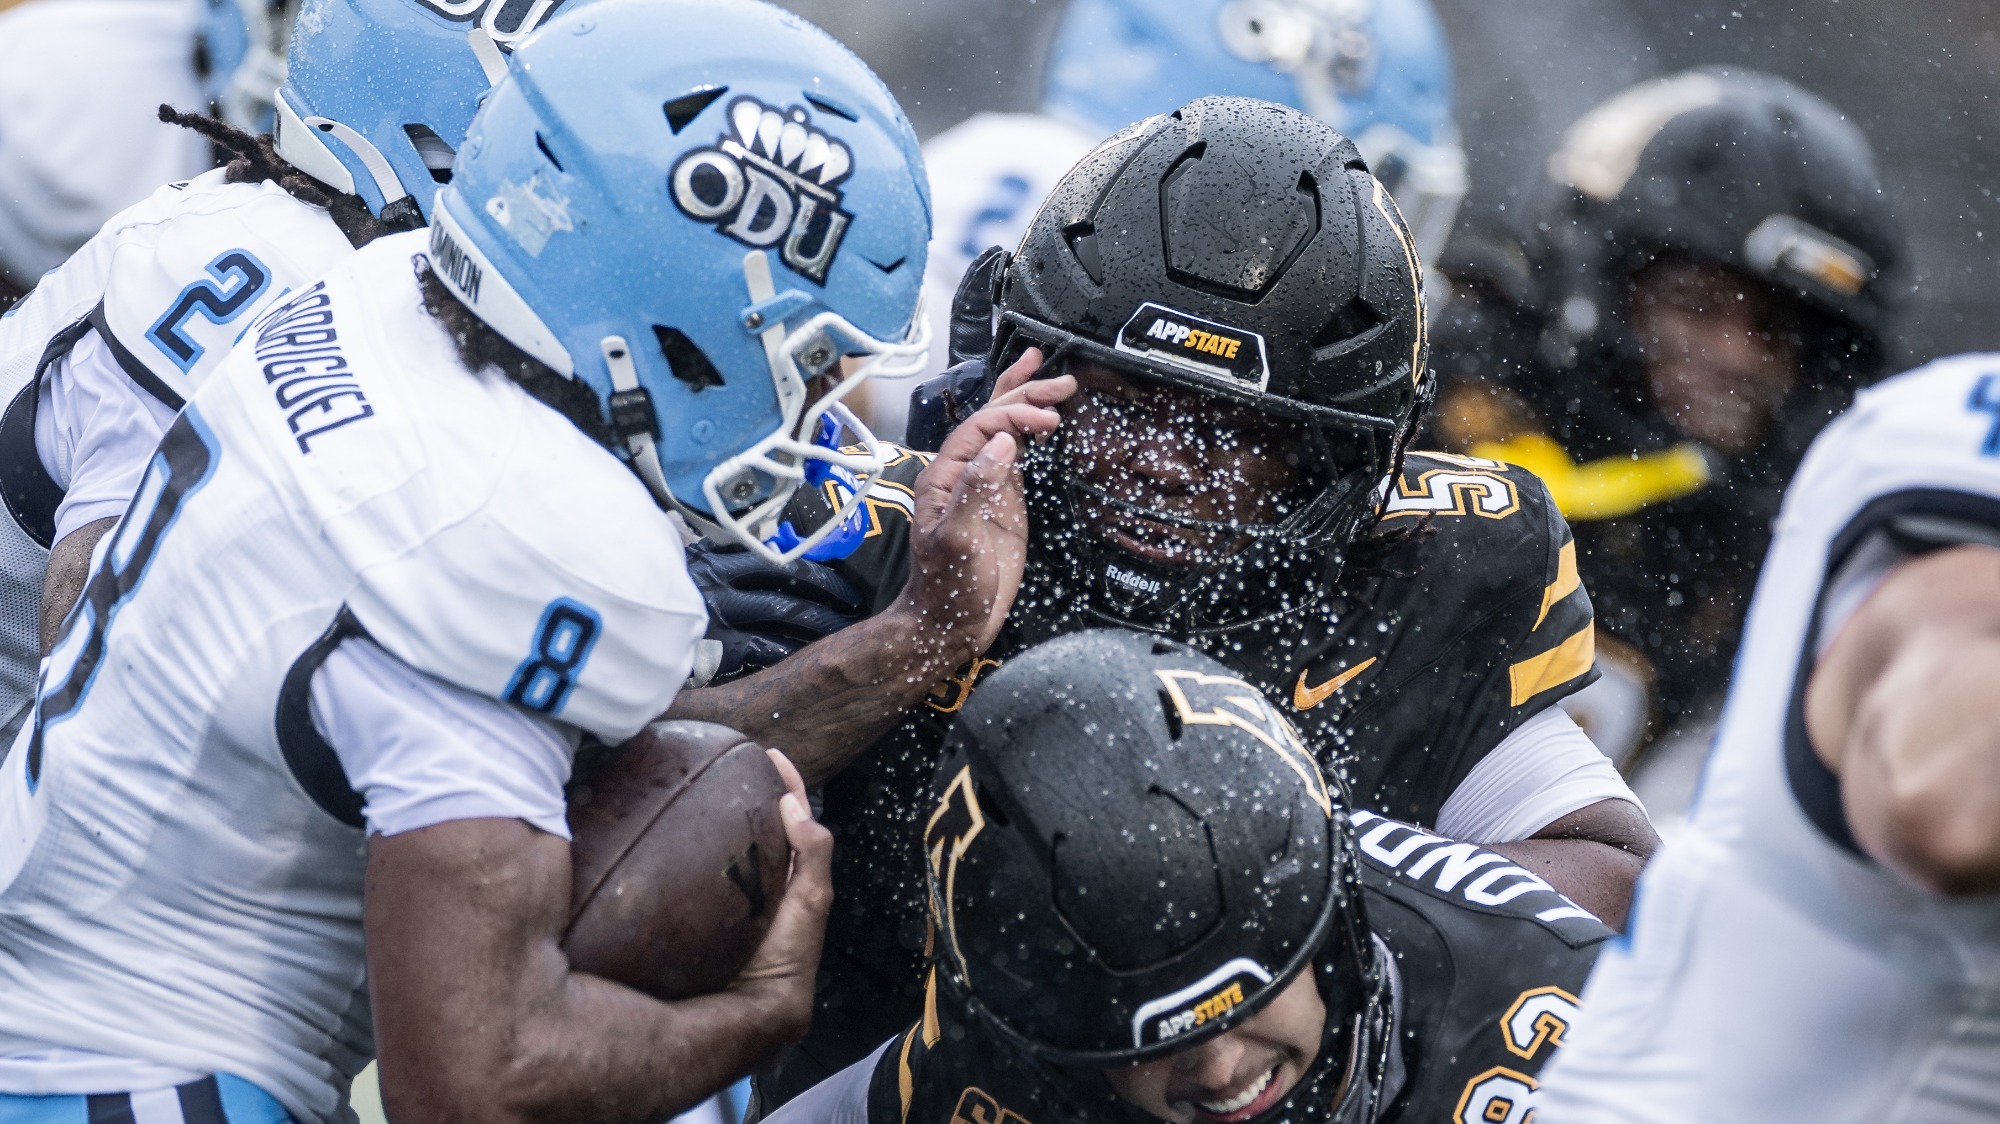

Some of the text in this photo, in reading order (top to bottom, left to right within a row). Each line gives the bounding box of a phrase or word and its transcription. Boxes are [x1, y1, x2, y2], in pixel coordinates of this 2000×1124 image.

[668, 146, 855, 287] ODU
[144, 248, 291, 375] 2
[1105, 564, 1161, 594] Riddell
[501, 597, 603, 718] 8
